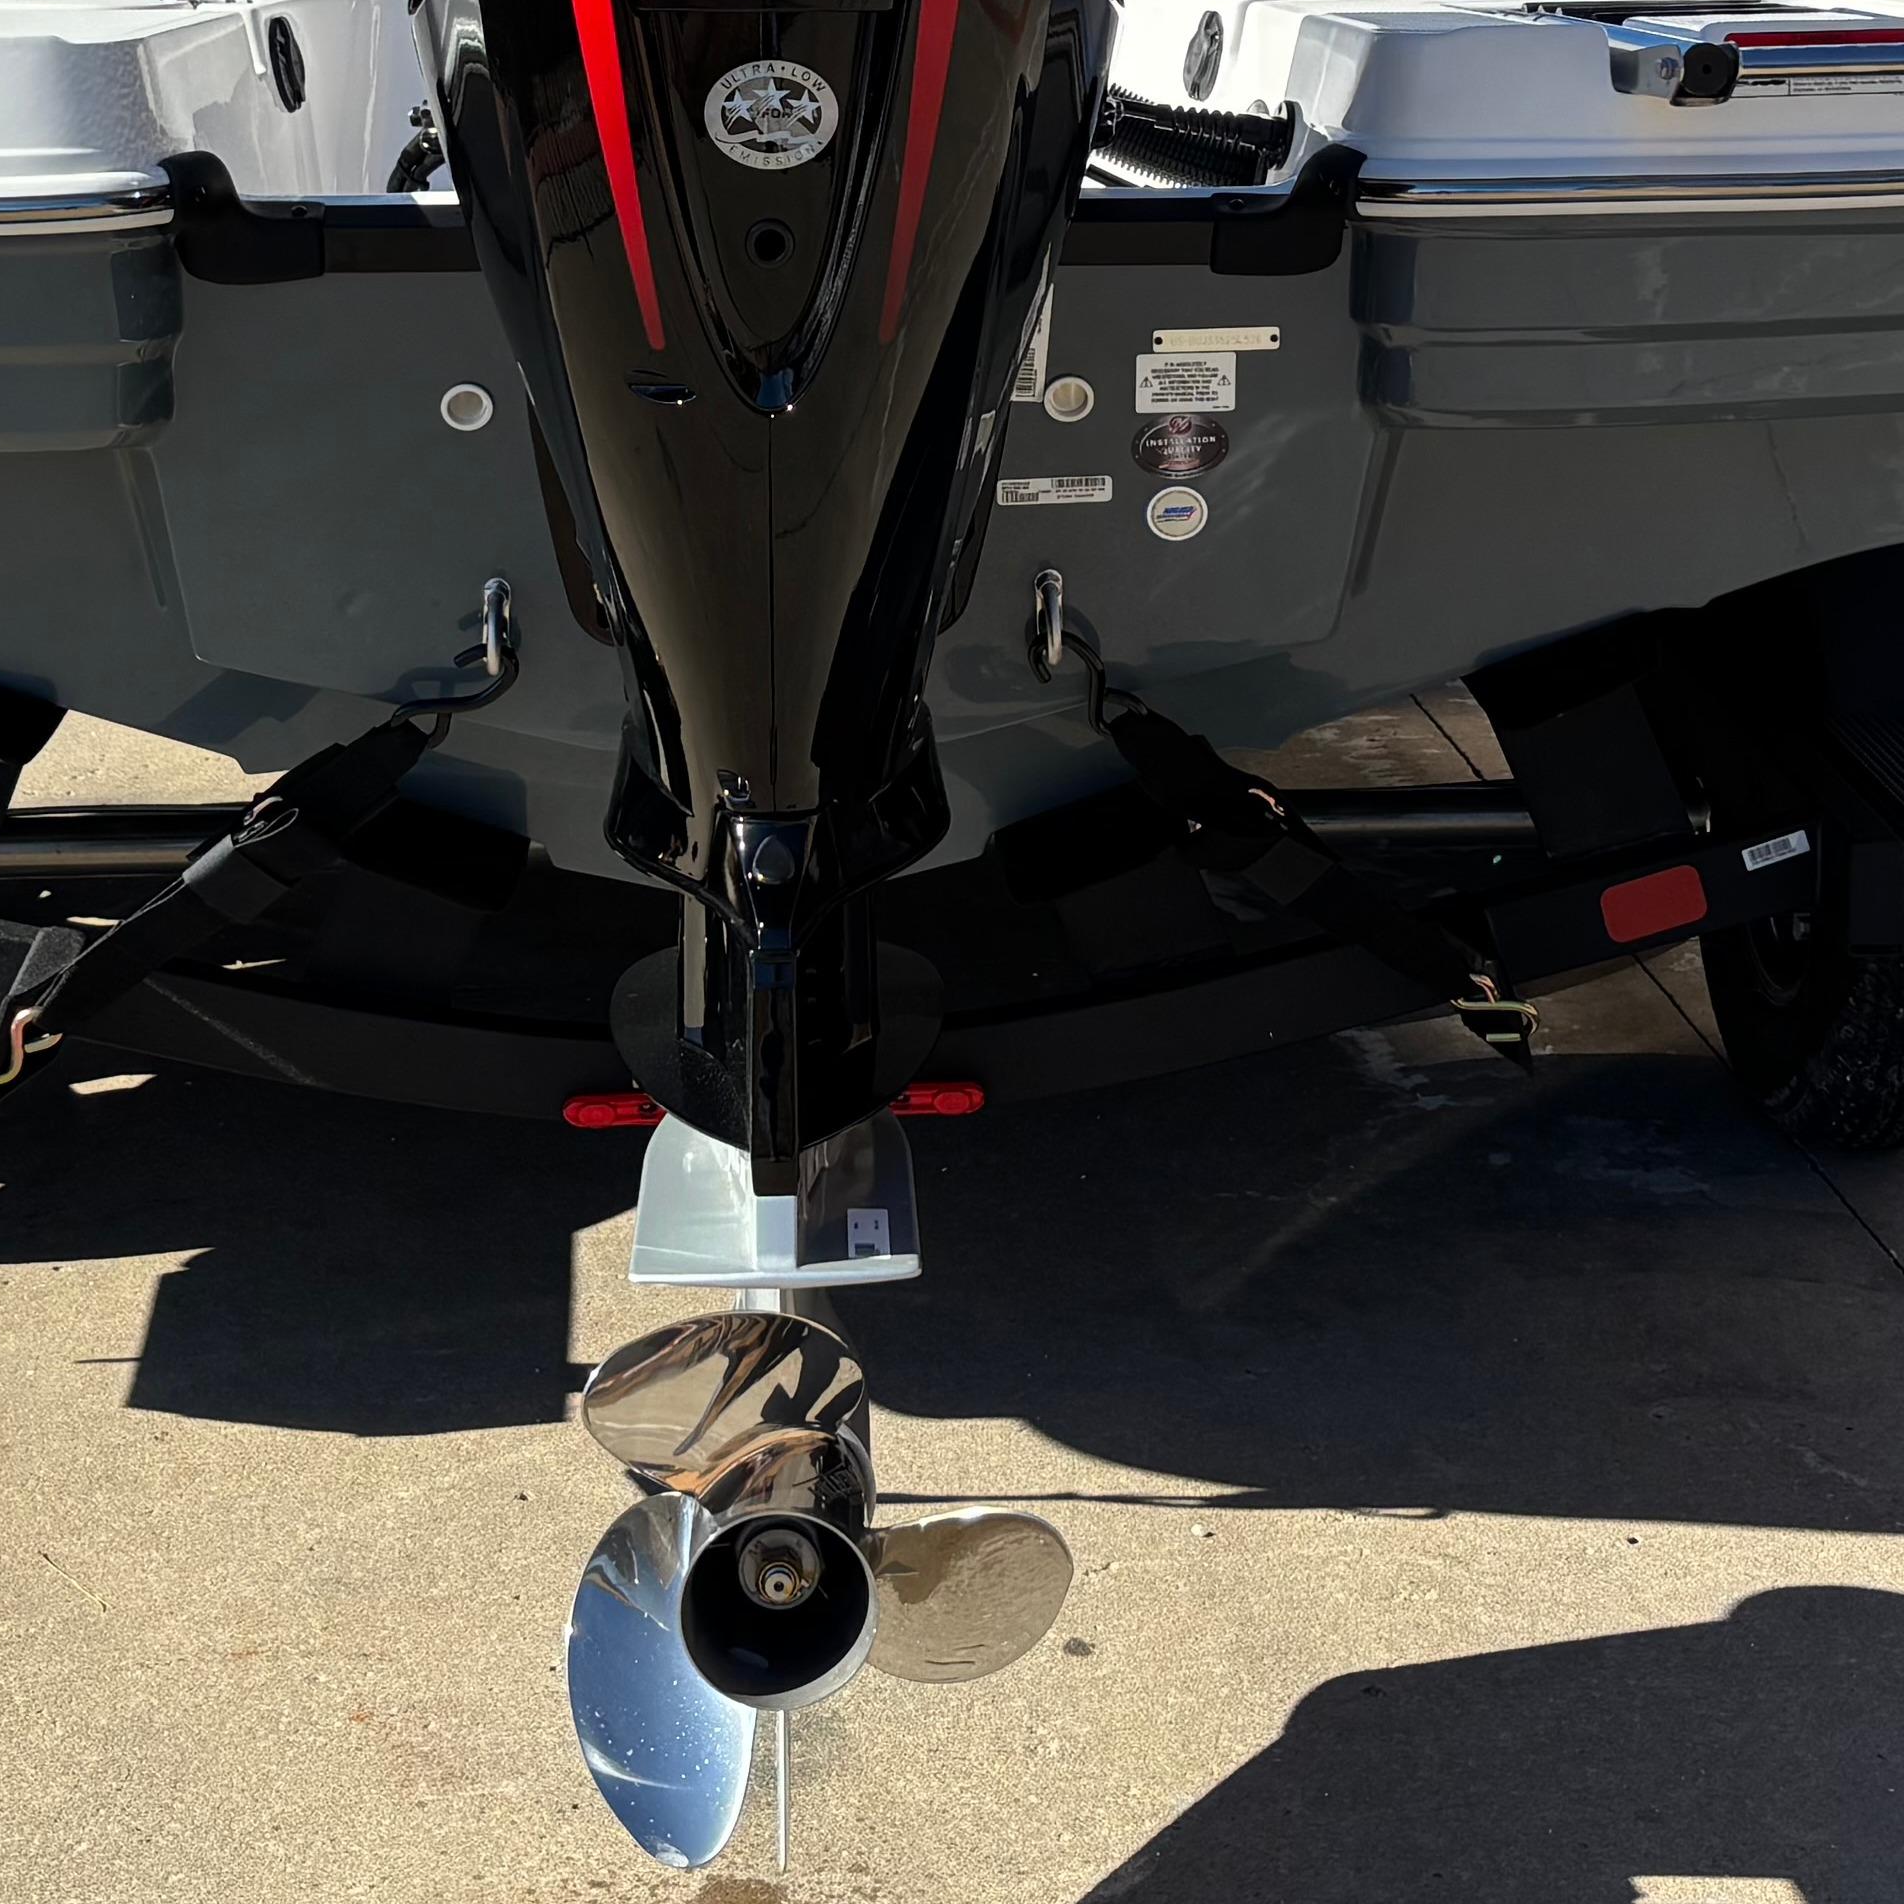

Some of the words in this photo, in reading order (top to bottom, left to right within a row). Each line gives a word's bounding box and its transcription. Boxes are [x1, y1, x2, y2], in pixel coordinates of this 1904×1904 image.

[721, 63, 775, 90] ULTRA
[792, 68, 826, 92] LOW
[729, 144, 815, 166] EMISSION
